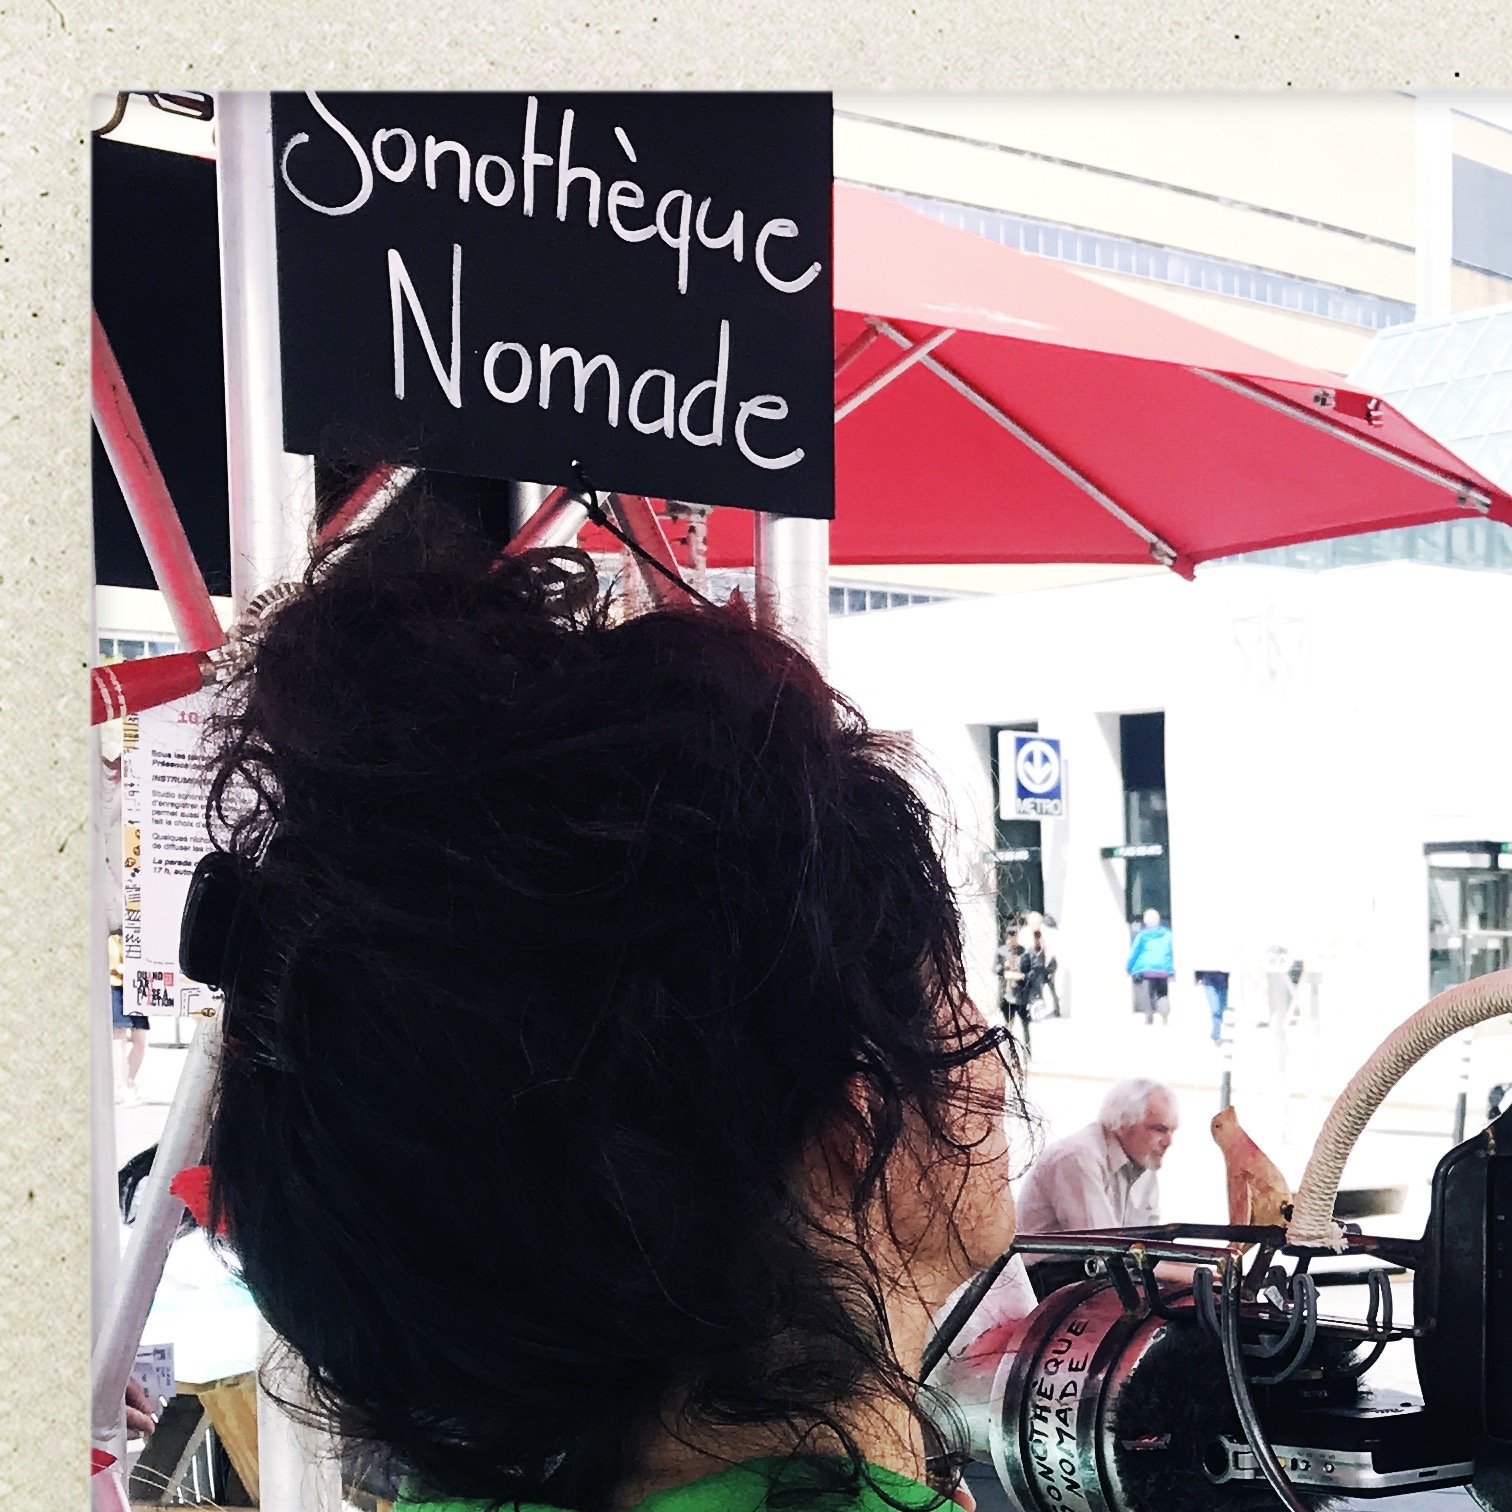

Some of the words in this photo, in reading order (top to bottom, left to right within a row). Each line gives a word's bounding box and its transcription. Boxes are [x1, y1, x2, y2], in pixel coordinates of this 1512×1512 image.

[280, 92, 822, 294] Sonothèque
[388, 244, 805, 470] Nomade
[1055, 1352, 1088, 1498] NOMADE
